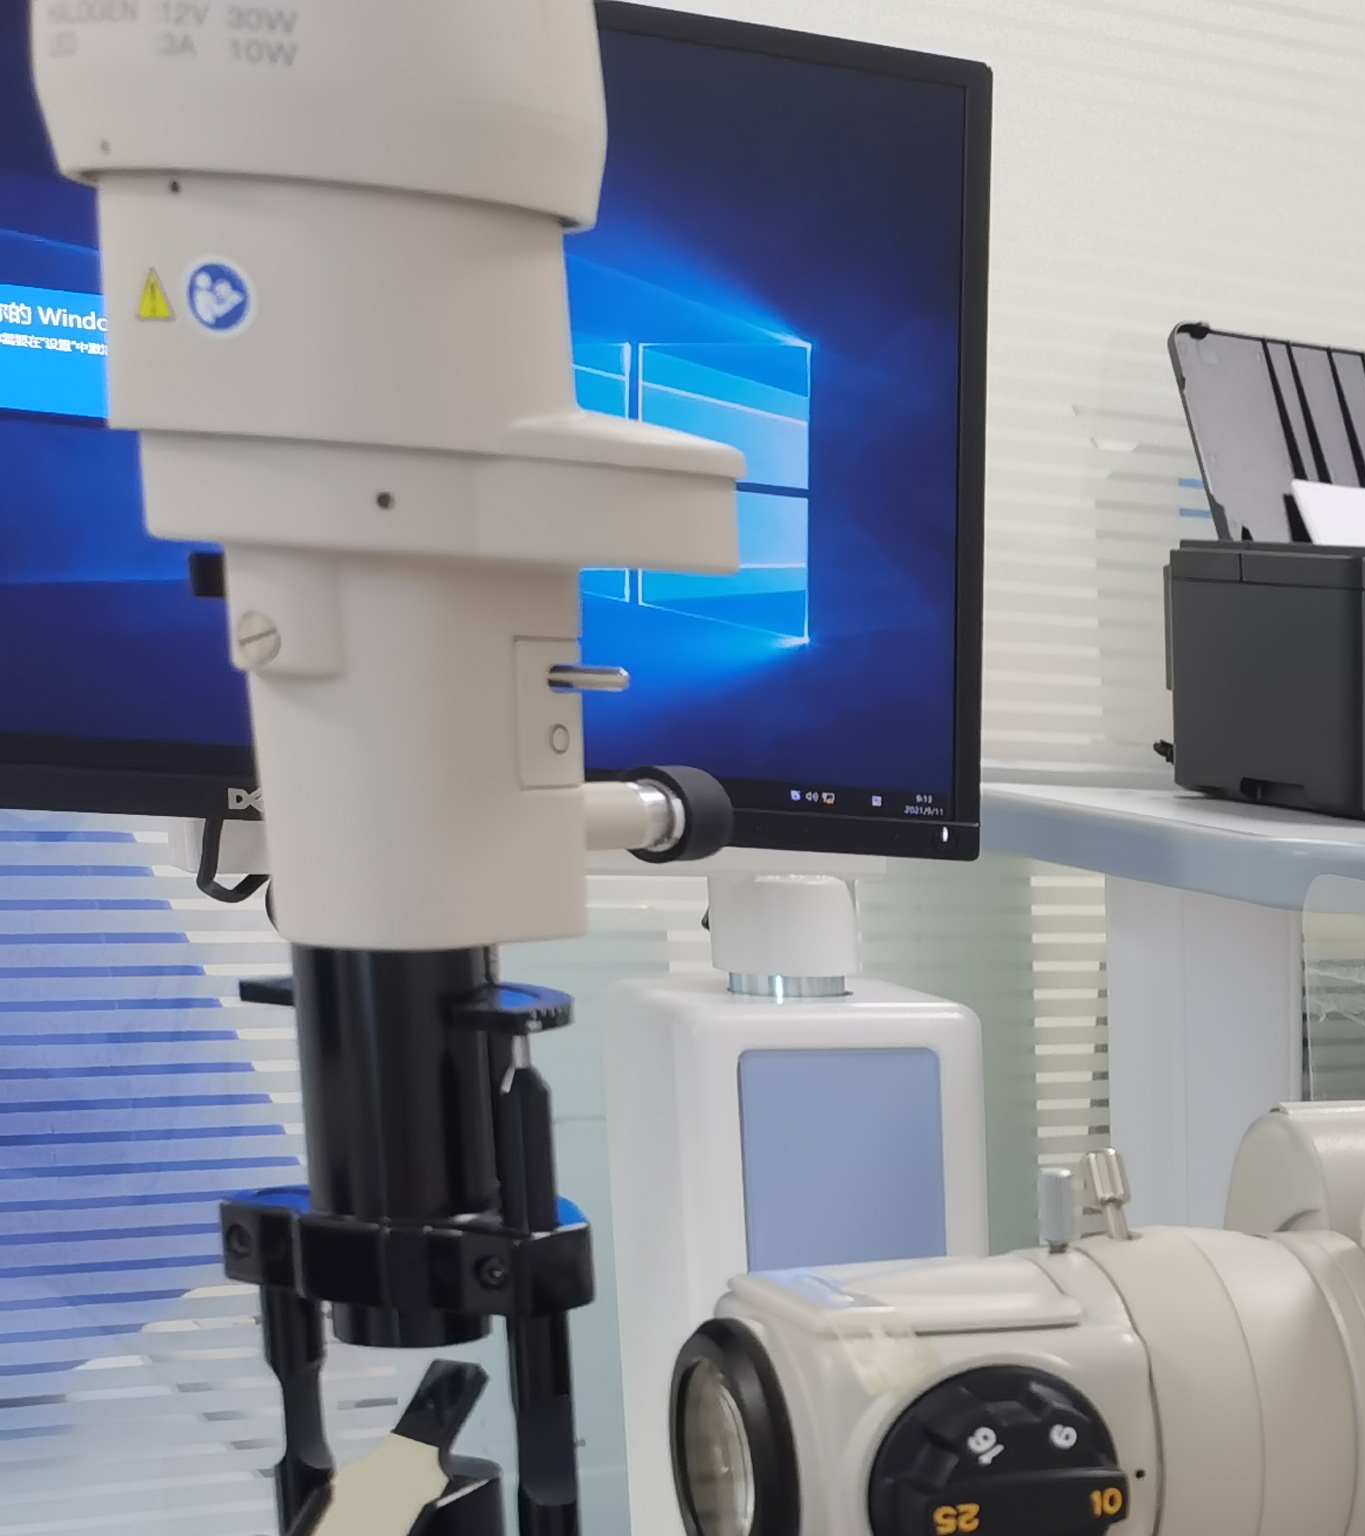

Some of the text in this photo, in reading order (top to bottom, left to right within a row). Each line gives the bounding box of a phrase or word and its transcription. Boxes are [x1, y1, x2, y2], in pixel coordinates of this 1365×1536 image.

[230, 37, 297, 66] 10W
[1089, 1487, 1123, 1517] 10
[932, 1503, 981, 1536] 25
